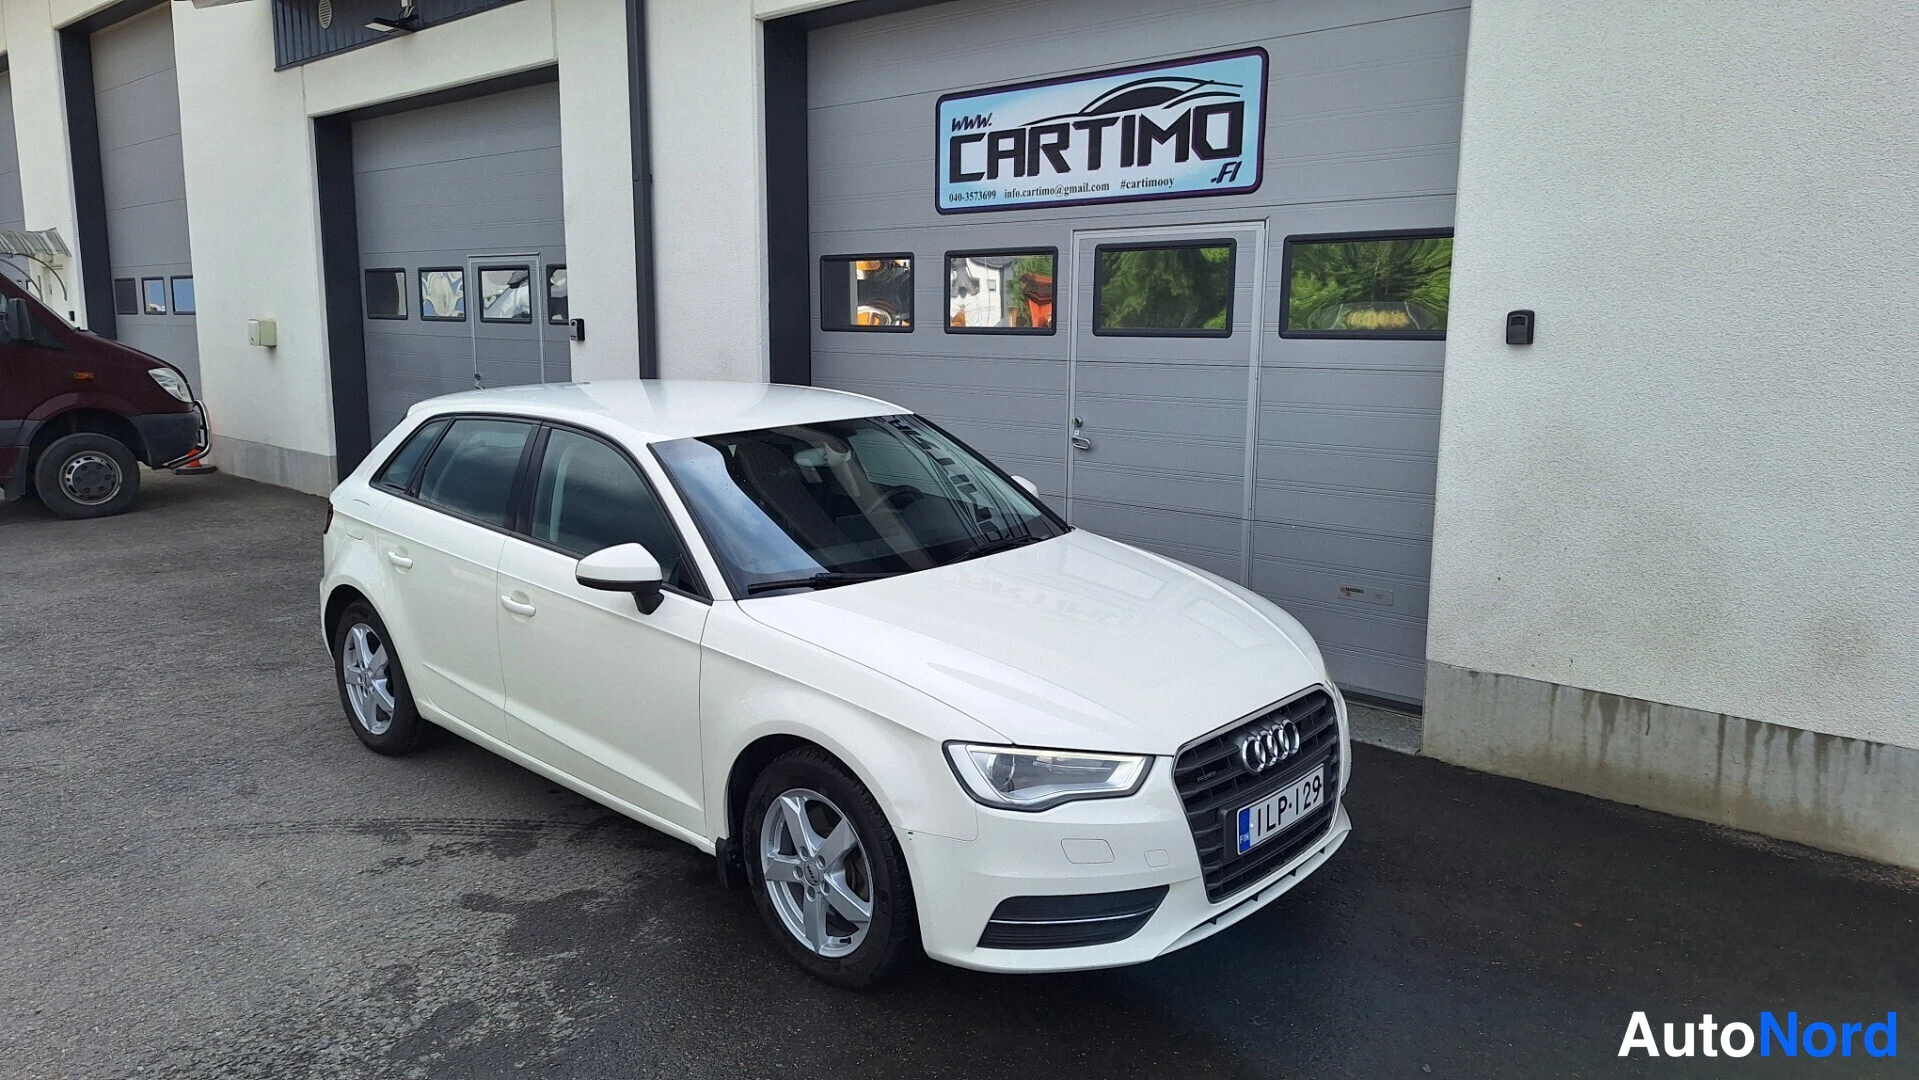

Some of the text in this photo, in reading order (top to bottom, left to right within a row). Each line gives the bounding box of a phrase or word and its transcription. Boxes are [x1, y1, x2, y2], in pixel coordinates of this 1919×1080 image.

[949, 101, 1245, 184] CARTIMO
[948, 176, 1175, 203] 040-3573699 info.cartimo@gmail.com #cartimooy
[1257, 775, 1322, 837] ILP-129
